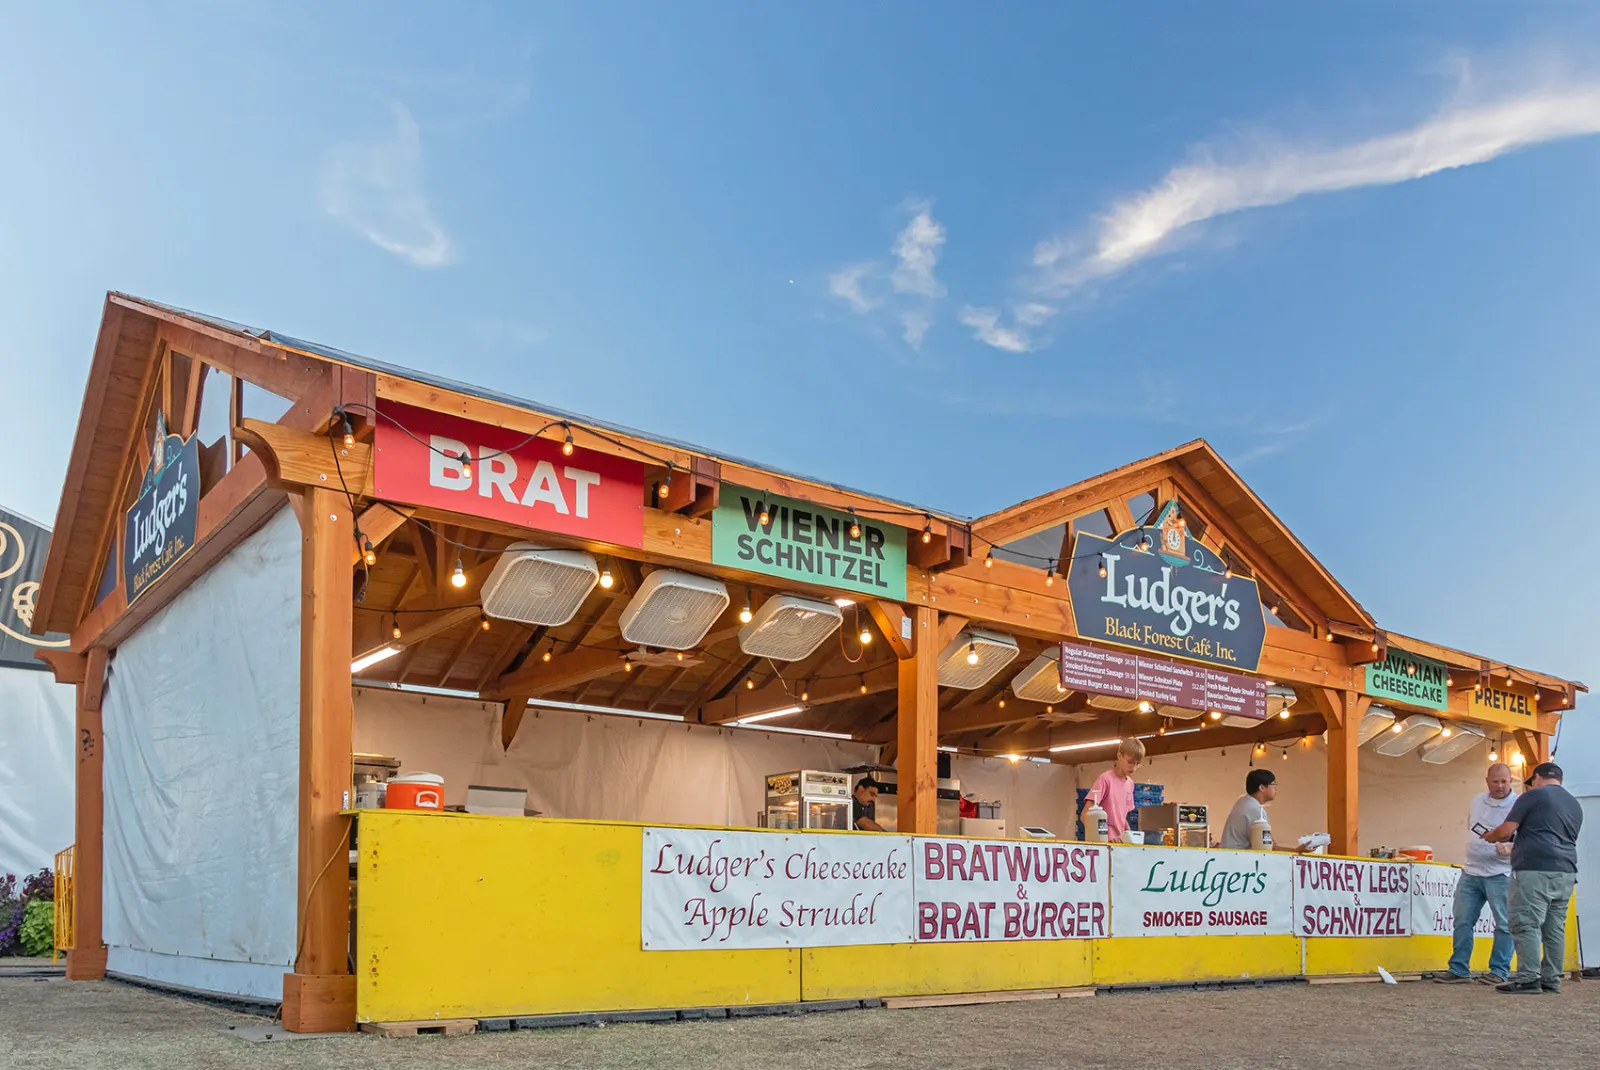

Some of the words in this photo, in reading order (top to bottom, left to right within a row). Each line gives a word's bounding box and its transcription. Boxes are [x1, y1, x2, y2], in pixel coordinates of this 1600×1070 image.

[429, 434, 601, 520] BRAT
[133, 461, 188, 564] Ludger's
[740, 496, 886, 560] WIENER
[737, 534, 888, 588] SCHNITZEL
[1101, 552, 1240, 636] Ludger's
[1104, 617, 1141, 641] Black
[1143, 625, 1183, 650] Forest
[1185, 635, 1213, 658] Café,
[1215, 641, 1237, 662] Inc.
[1373, 673, 1442, 704] CHEESECAKE
[1475, 687, 1531, 717] PRETZEL
[650, 839, 776, 893] Ludger's
[785, 847, 907, 880] Cheesecake
[924, 842, 1099, 883] BRATWURST
[1140, 858, 1267, 907] Ludger's
[1296, 859, 1364, 892] TURKEY
[1369, 865, 1409, 893] LEGS
[1016, 883, 1028, 900] &
[1353, 893, 1361, 906] &
[684, 892, 769, 942] Apple
[779, 892, 883, 927] Strudel
[918, 902, 996, 940] BRAT
[1004, 902, 1105, 939] BURGER
[1143, 910, 1203, 928] SMOKED
[1207, 910, 1268, 926] SAUSAGE
[1302, 905, 1405, 935] SCHNITZEL
[1433, 903, 1453, 931] Hot
